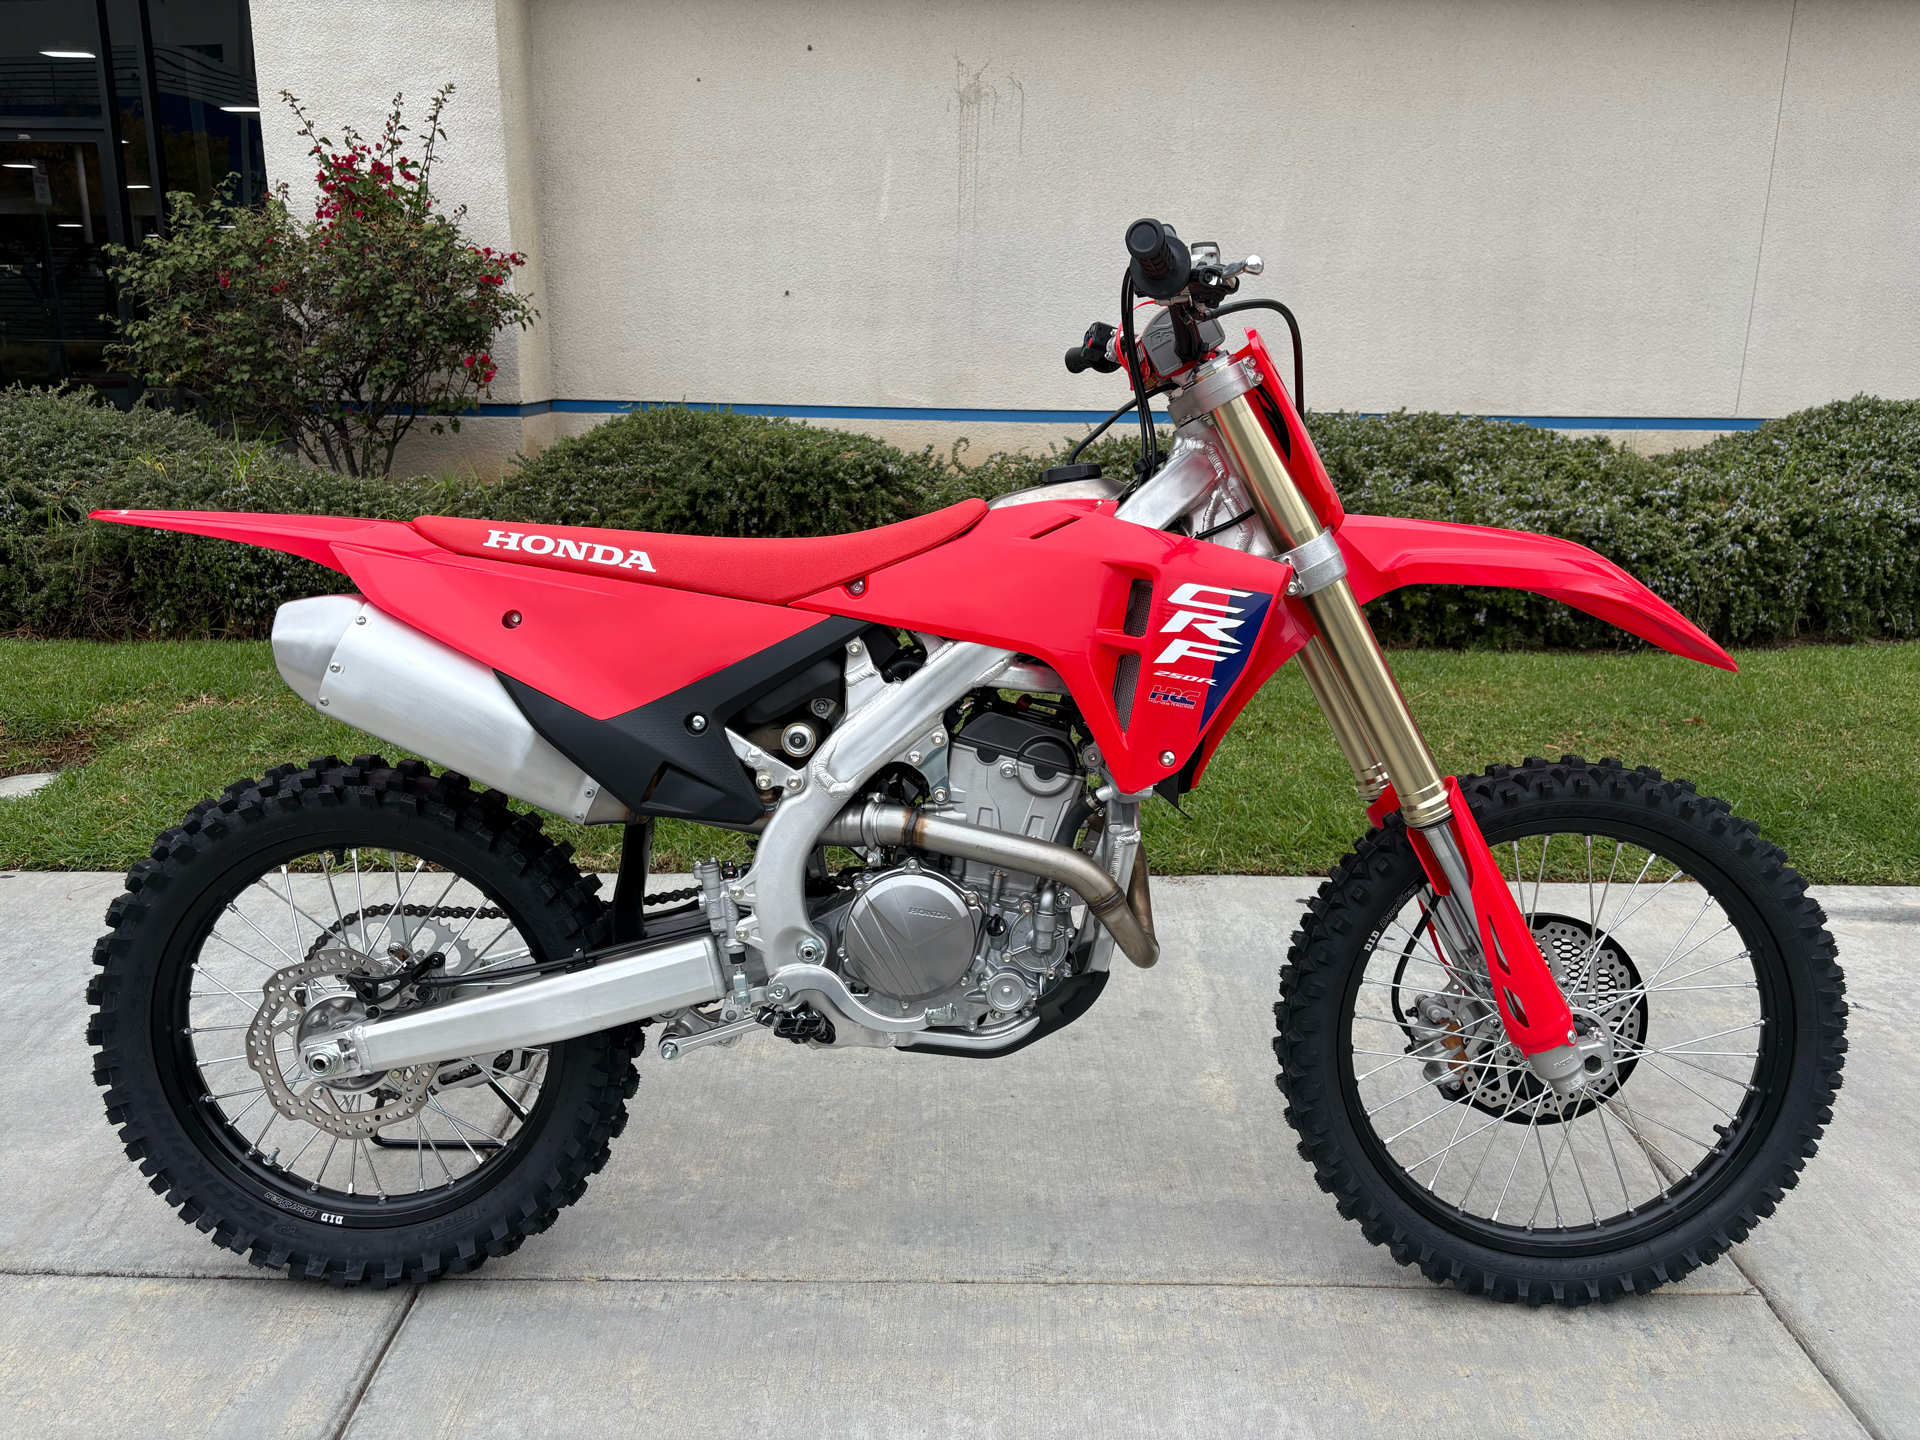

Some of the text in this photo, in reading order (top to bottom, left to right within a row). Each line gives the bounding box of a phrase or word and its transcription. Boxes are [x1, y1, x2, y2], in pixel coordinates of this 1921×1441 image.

[483, 529, 657, 573] HONDA
[1153, 583, 1254, 664] CRF
[1153, 670, 1218, 687] 250R
[1149, 685, 1201, 706] HRC
[908, 907, 952, 920] HONDA
